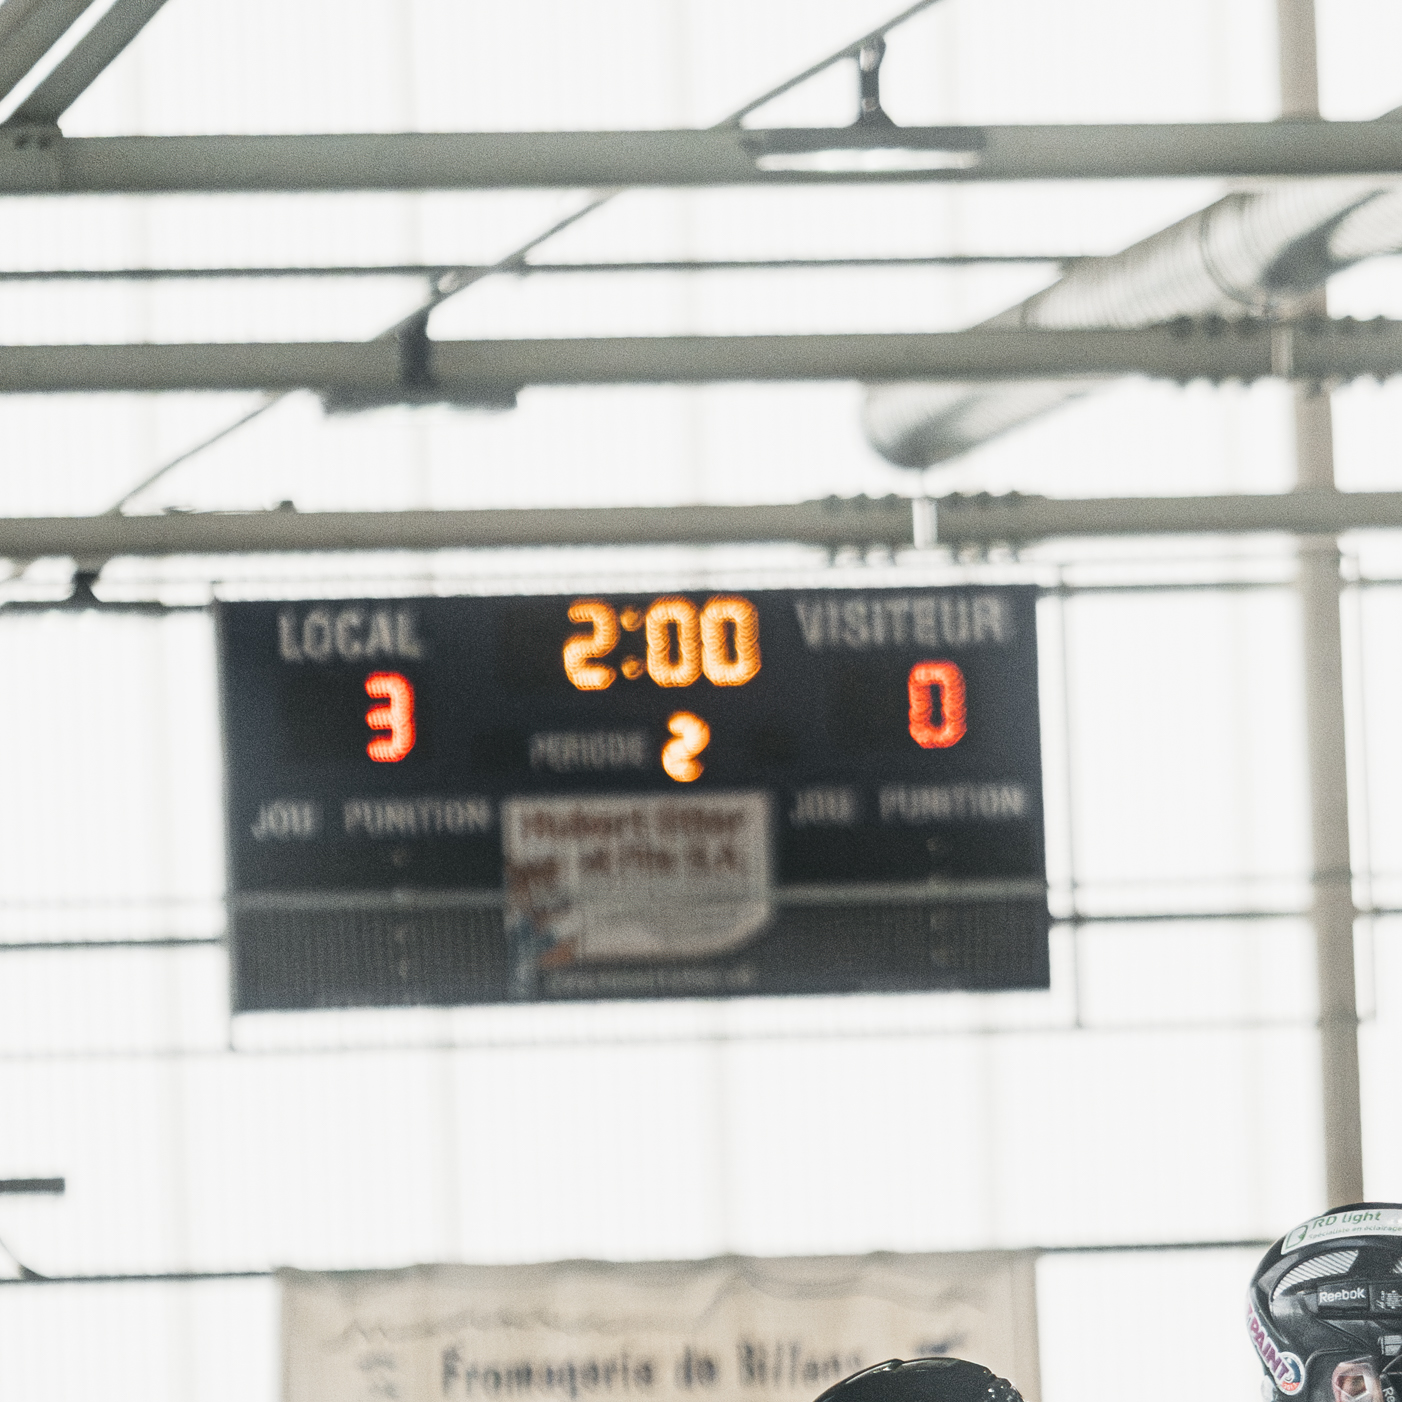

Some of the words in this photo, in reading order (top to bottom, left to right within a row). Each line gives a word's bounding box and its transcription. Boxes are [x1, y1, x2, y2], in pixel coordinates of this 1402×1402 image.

[277, 605, 426, 662] LOCAL
[563, 594, 761, 691] 2:00
[794, 593, 1007, 650] VISITEUR
[365, 671, 417, 762] 3
[908, 659, 967, 750] 0
[661, 710, 711, 782] 2
[1312, 1214, 1338, 1231] RD
[1342, 1210, 1382, 1226] light
[1319, 1287, 1367, 1304] Reebok
[1250, 1316, 1290, 1382] PAINT
